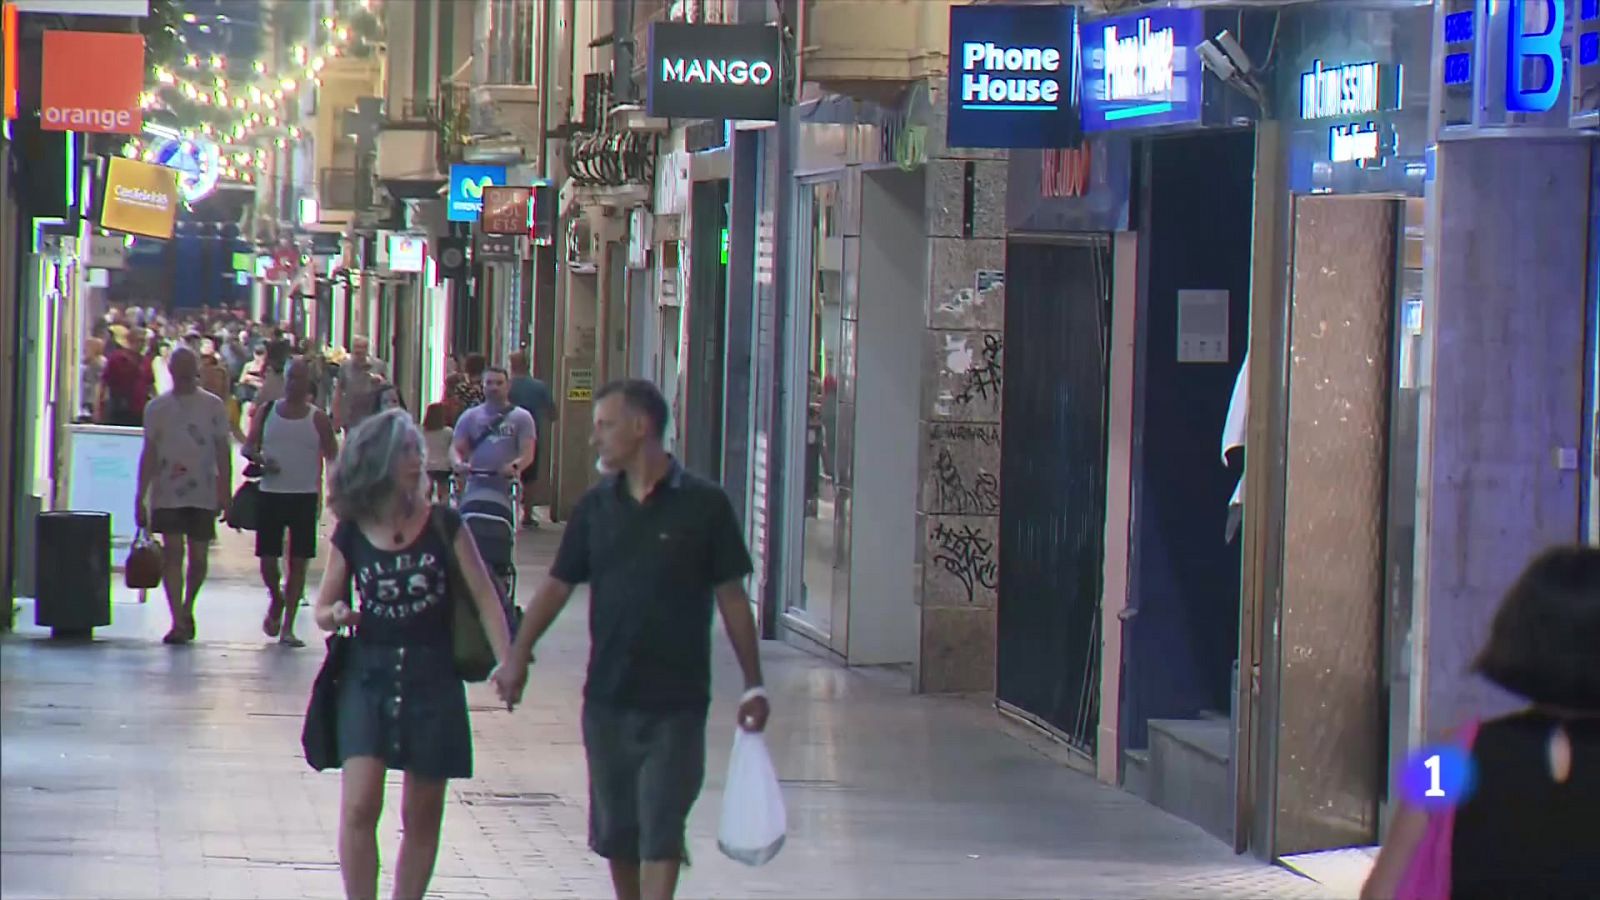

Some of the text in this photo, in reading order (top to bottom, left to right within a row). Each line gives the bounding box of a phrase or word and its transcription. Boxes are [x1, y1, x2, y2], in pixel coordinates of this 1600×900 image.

[963, 42, 1060, 71] Phone
[662, 57, 773, 85] MANGO
[962, 74, 1059, 102] House
[45, 106, 131, 128] orange
